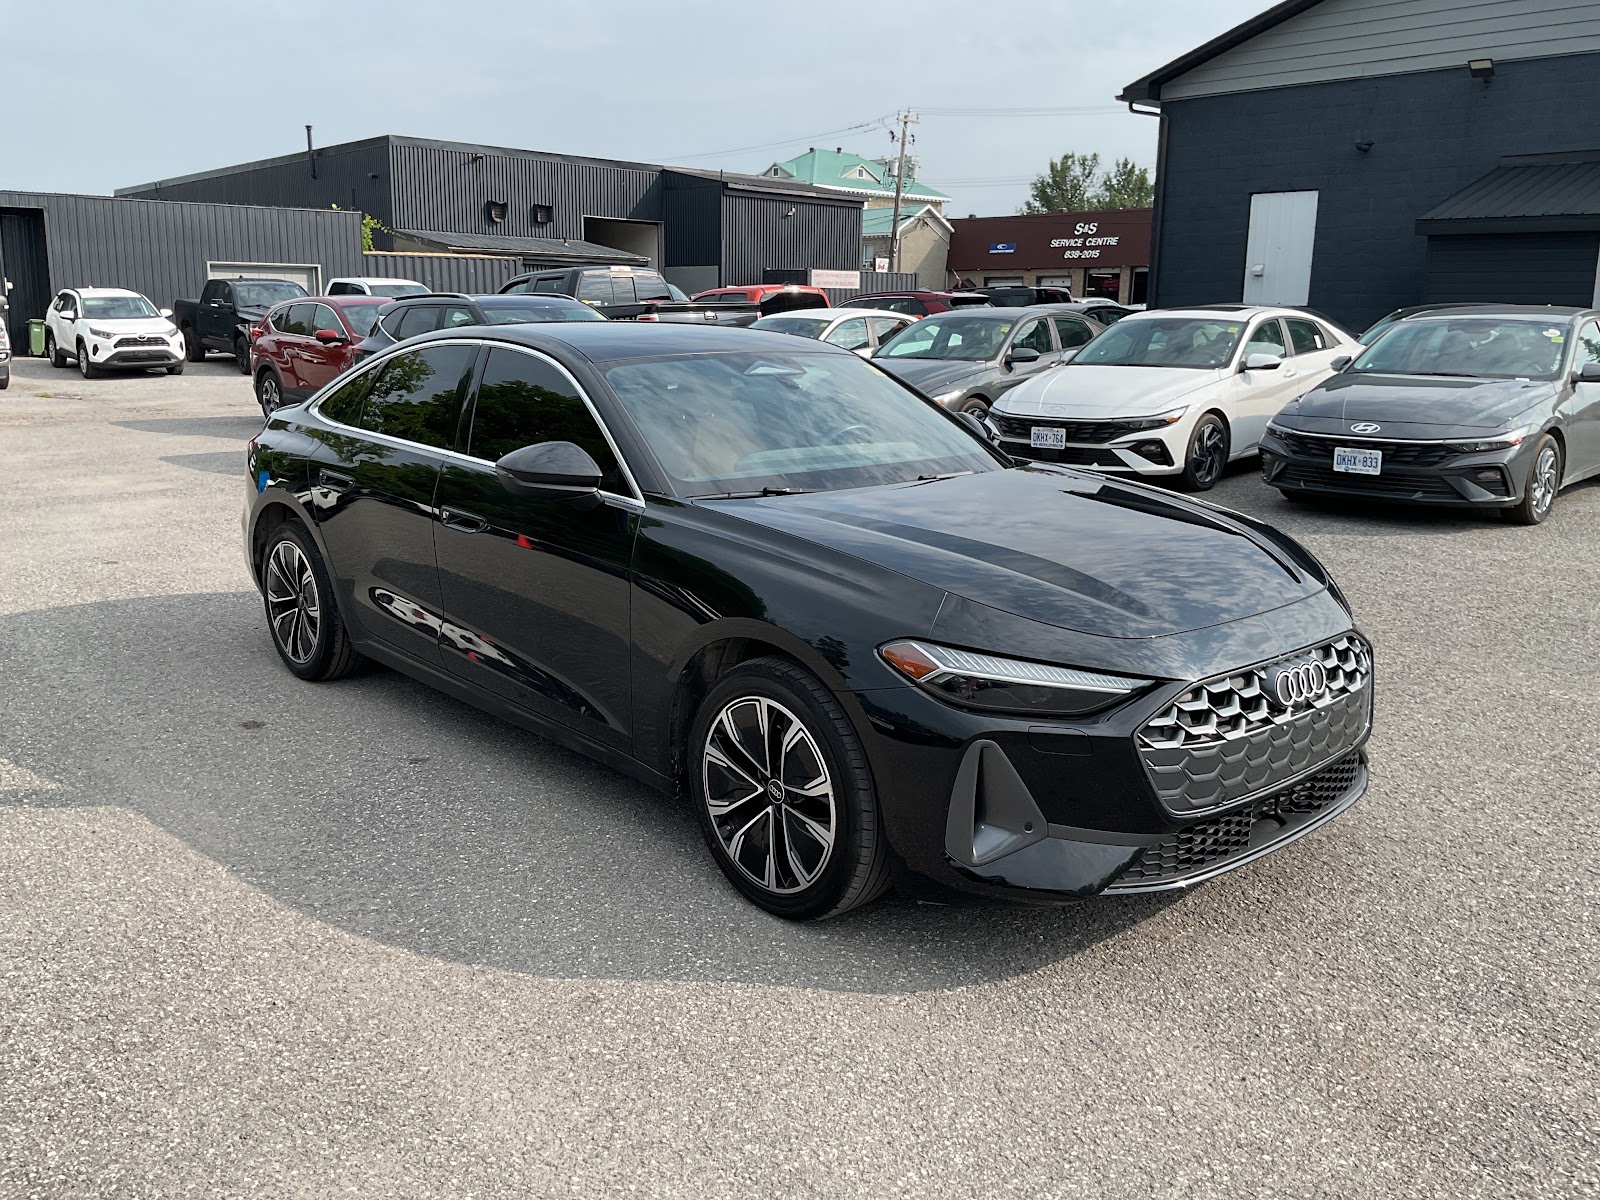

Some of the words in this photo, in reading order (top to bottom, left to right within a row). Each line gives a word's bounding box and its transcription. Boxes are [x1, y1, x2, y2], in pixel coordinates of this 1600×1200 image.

[1074, 222, 1098, 235] S&S
[1050, 238, 1084, 247] SERVICE
[1086, 237, 1119, 246] CENTRE
[1064, 250, 1100, 259] 838-2015
